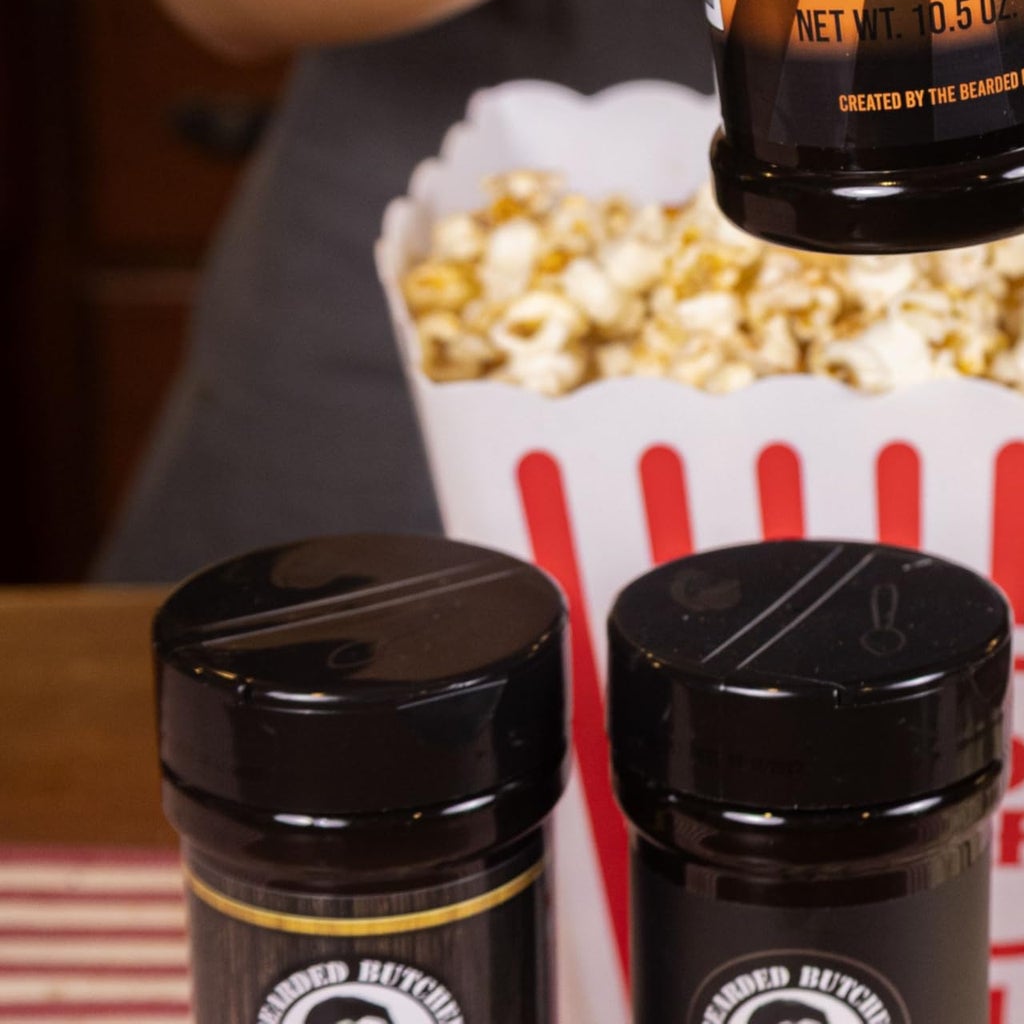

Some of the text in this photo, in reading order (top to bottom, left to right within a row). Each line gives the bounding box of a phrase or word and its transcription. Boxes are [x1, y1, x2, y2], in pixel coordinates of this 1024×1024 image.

[796, 9, 844, 43] NET
[853, 8, 902, 40] WT.
[839, 90, 901, 113] CREATED
[906, 89, 925, 109] BY
[928, 85, 956, 106] THE
[960, 72, 1019, 100] BEARDED
[257, 960, 349, 1024] EARDED
[701, 965, 790, 1024] EARDED
